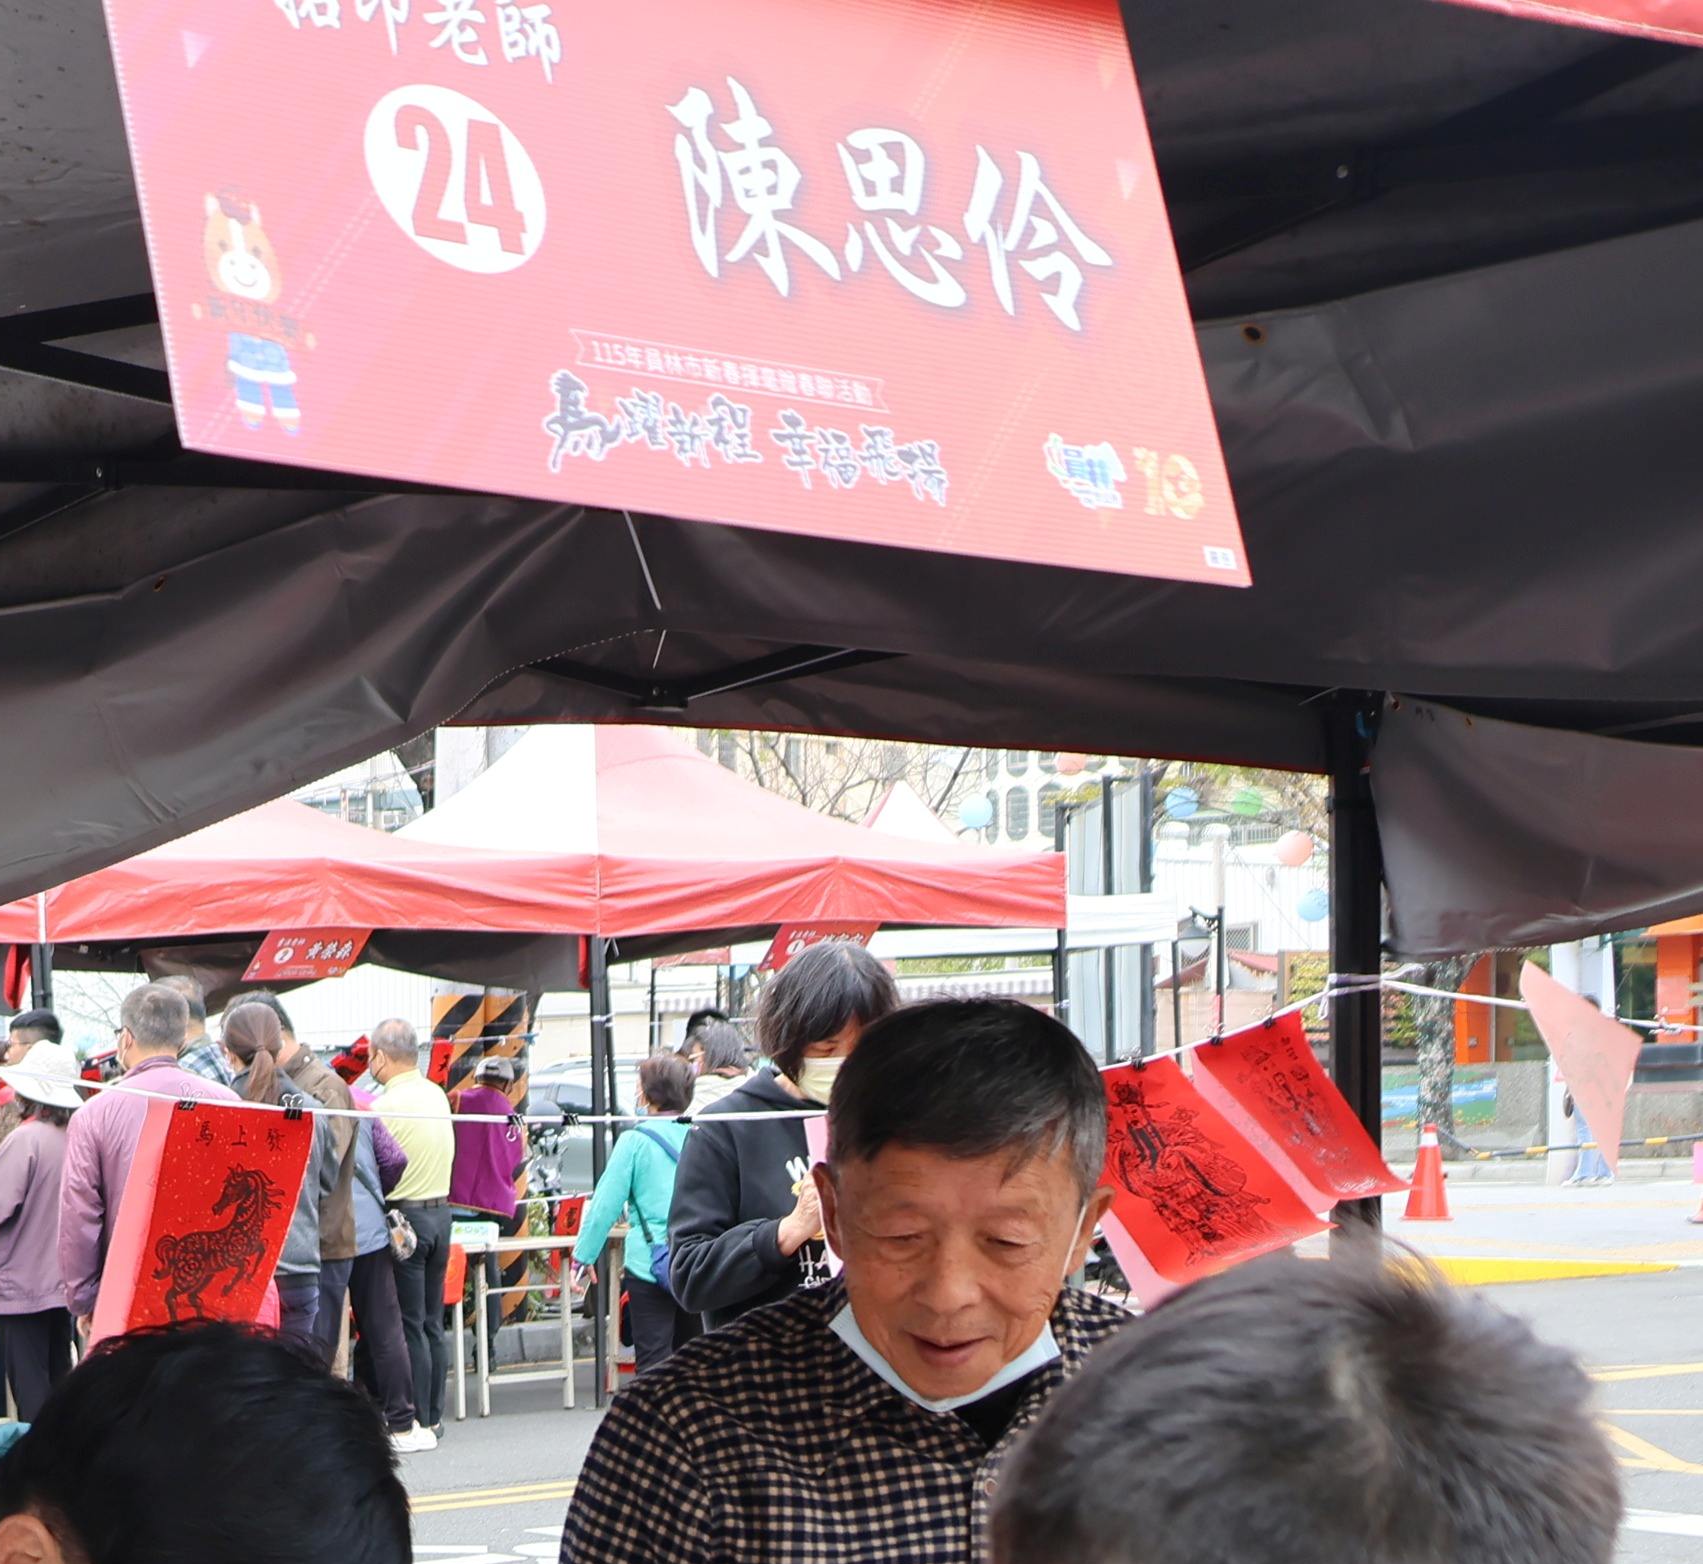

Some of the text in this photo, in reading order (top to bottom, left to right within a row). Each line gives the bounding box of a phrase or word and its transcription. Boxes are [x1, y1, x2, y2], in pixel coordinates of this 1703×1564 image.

[393, 103, 527, 256] 24
[665, 75, 1113, 332] 陳思伶
[770, 408, 949, 506] 幸福飛揚
[195, 1120, 286, 1152] 馬上發
